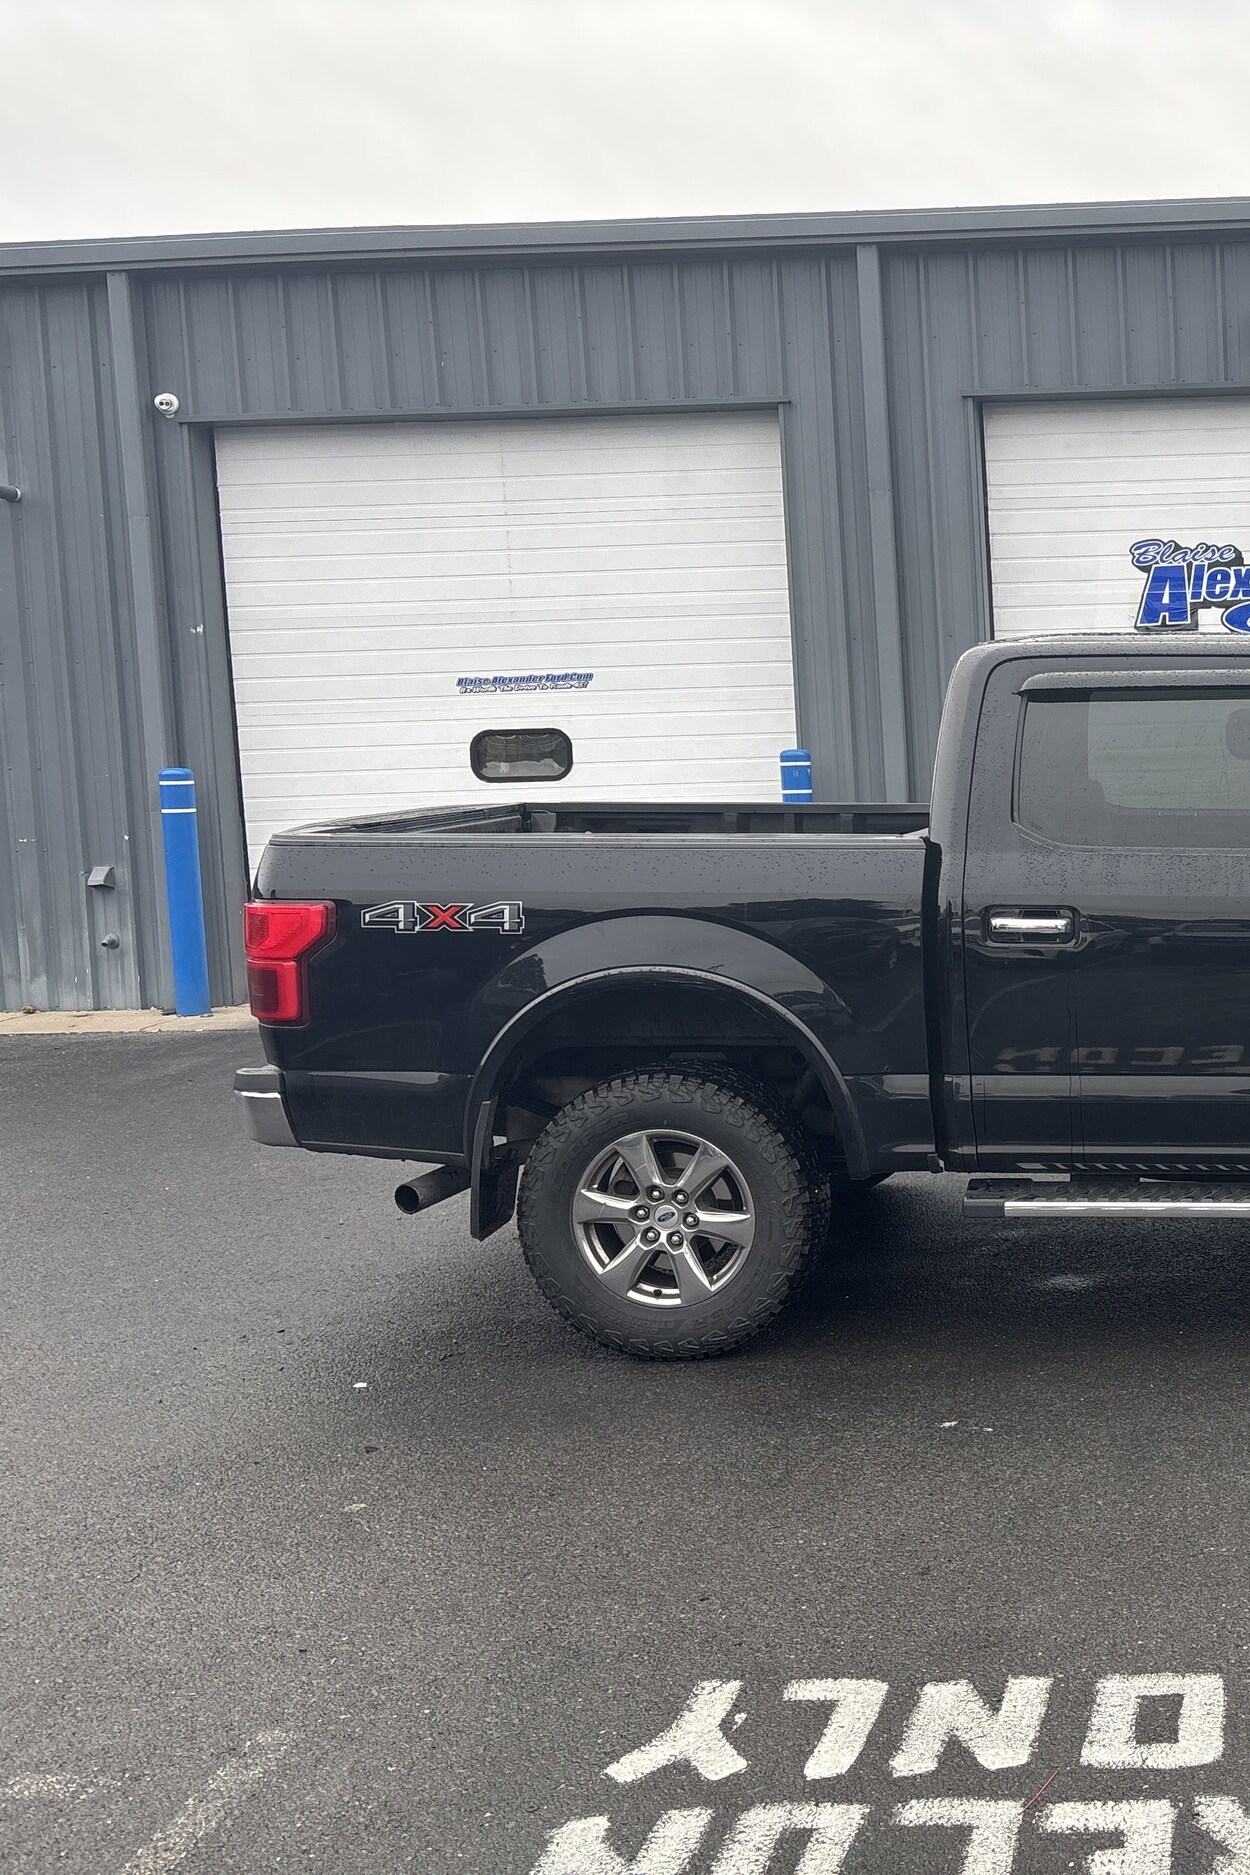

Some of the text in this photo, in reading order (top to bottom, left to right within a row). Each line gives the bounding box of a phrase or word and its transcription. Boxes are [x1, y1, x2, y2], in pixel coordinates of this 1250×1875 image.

[1131, 539, 1238, 566] Blaise
[456, 677, 491, 687] Blaise
[490, 675, 545, 685] Alexander
[602, 1672, 1225, 1783] ONLY
